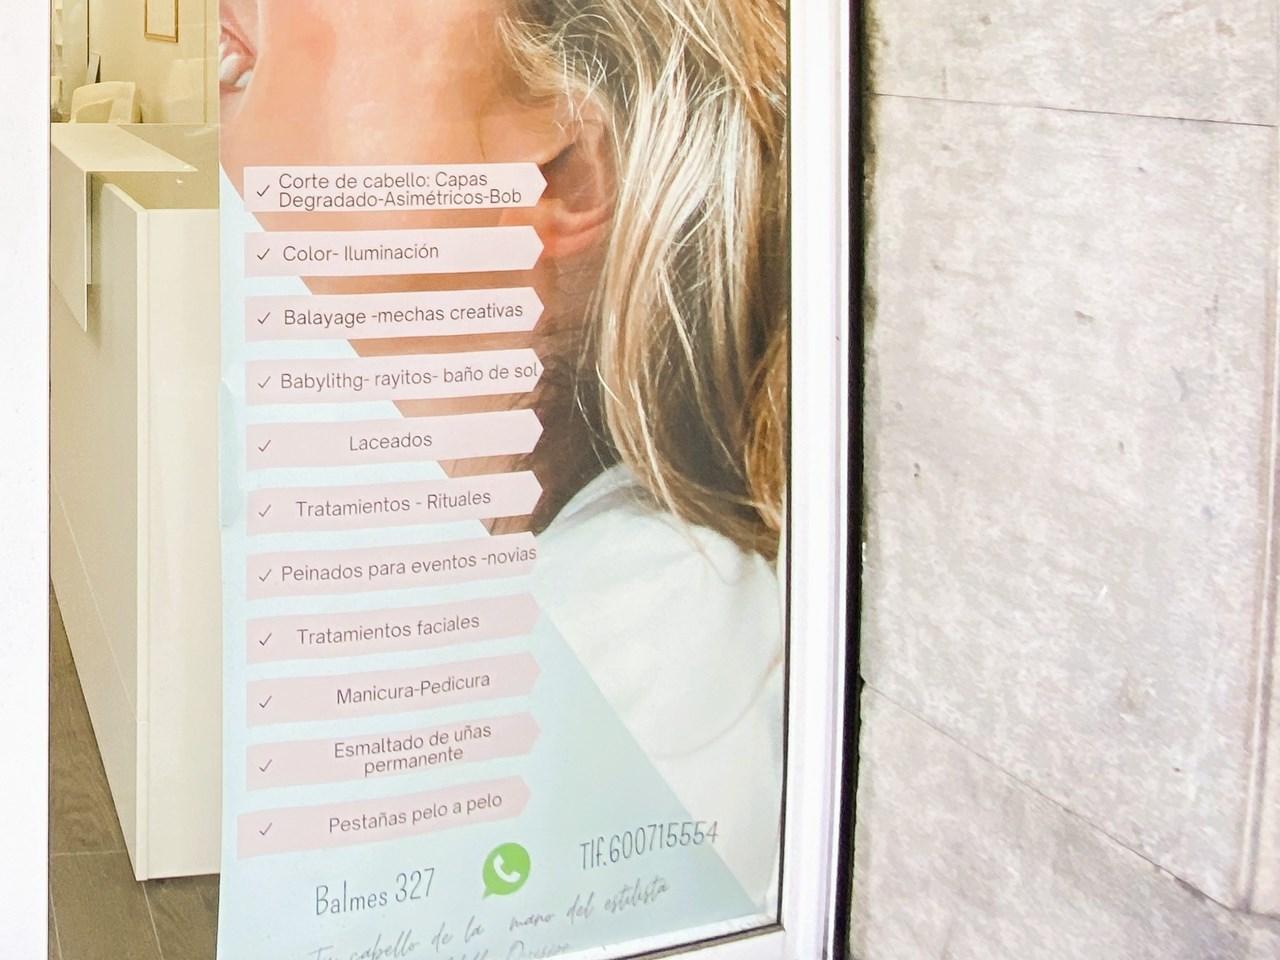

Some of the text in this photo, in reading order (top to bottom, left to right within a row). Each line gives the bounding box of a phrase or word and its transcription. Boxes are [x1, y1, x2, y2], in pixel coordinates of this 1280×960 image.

[278, 171, 488, 190] Corte de cabello: Capas
[278, 189, 522, 211] Degradado-Asimétricos-Bob
[282, 243, 439, 262] Color- Iluminación
[284, 302, 523, 328] Balayage -mechas creativas
[280, 362, 538, 392] Babylithg- rayitos- baño de sol
[349, 432, 433, 451] Laceados
[296, 496, 410, 517] Tratamientos
[427, 489, 491, 510] Rituales
[281, 545, 537, 582] Peinados para eventos -novias
[297, 615, 480, 645] Tratamientos faciales
[336, 674, 491, 705] Manicura-Pedicura
[334, 722, 492, 759] Esmaltado de uñas
[364, 747, 464, 778] permanente
[329, 791, 503, 834] Pestañas pelo a pelo
[580, 820, 719, 870] Tlf.600715554
[315, 868, 435, 917] Balmes 327
[431, 921, 453, 953] de
[464, 916, 484, 944] la
[566, 892, 594, 925] del
